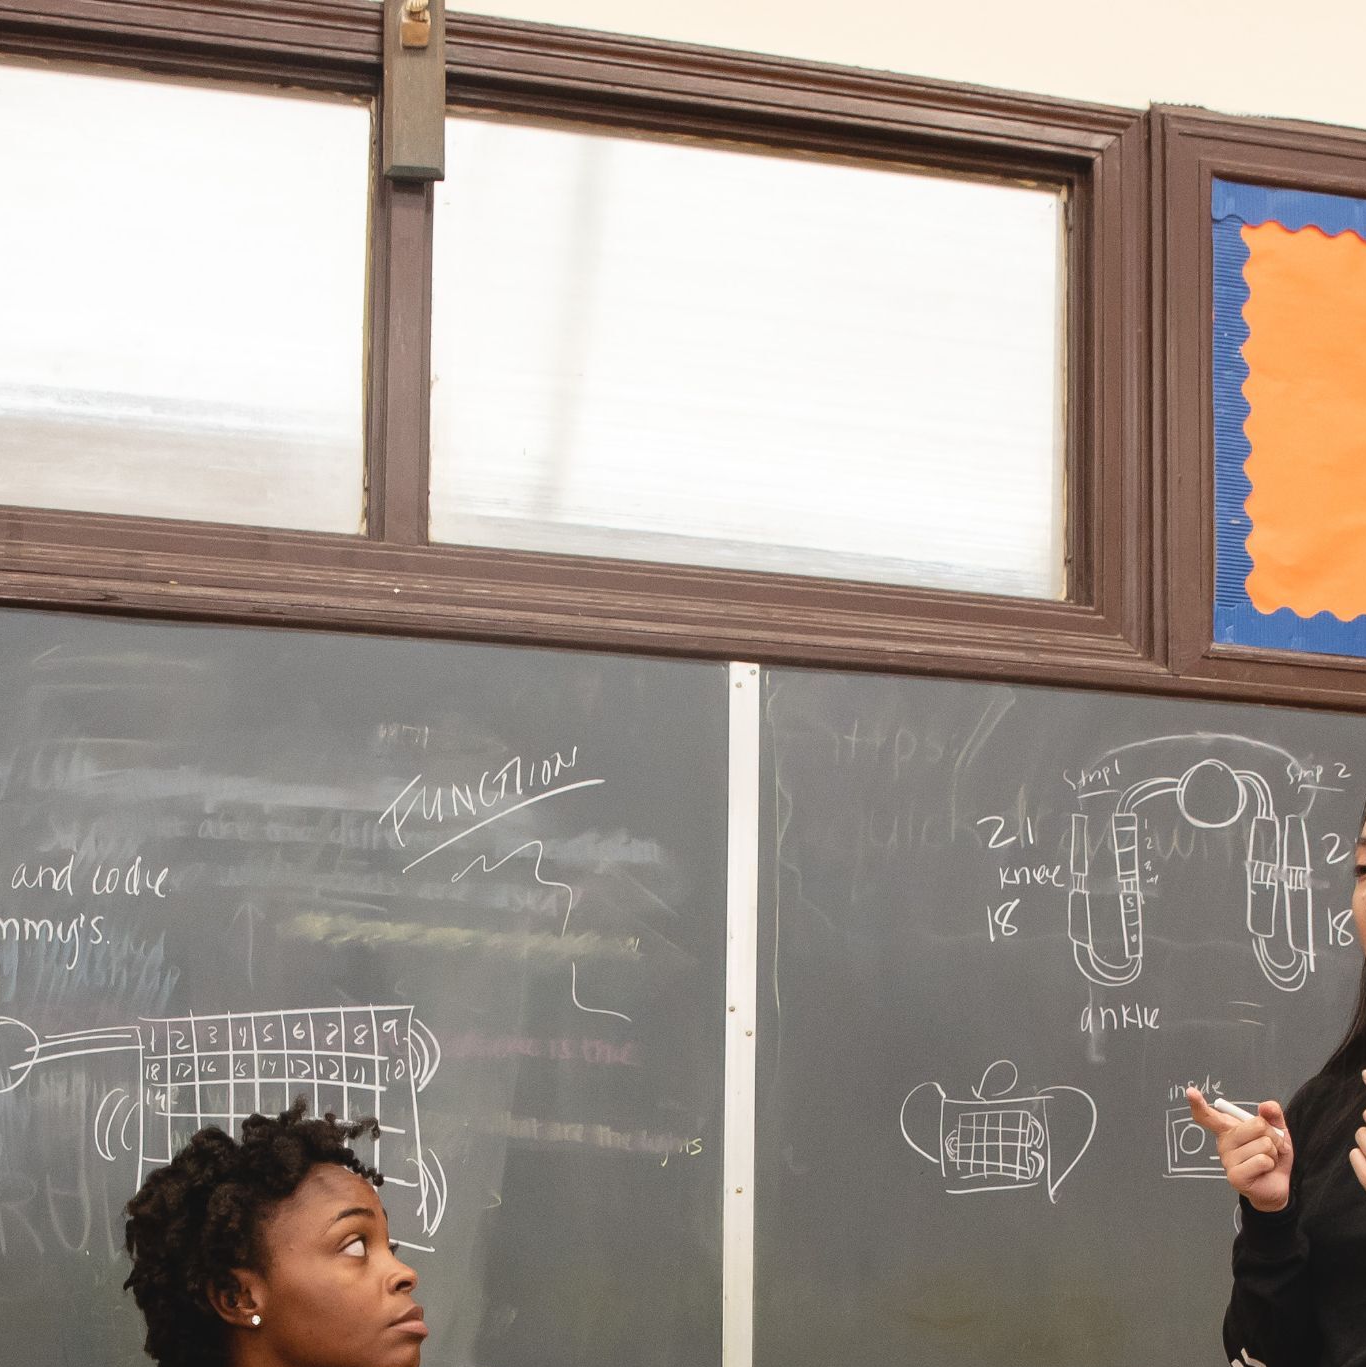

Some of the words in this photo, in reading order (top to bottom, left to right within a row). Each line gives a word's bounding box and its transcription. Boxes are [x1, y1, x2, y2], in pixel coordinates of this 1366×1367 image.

[378, 746, 578, 848] FUNCTION
[977, 814, 1034, 849] 21
[11, 854, 74, 897] and
[986, 898, 1021, 942] 18
[1327, 907, 1355, 947] 18
[169, 1030, 191, 1050] 2
[207, 1026, 218, 1045] 3
[291, 1021, 306, 1041] 6
[353, 1024, 369, 1046] 8
[382, 1018, 400, 1047] 9
